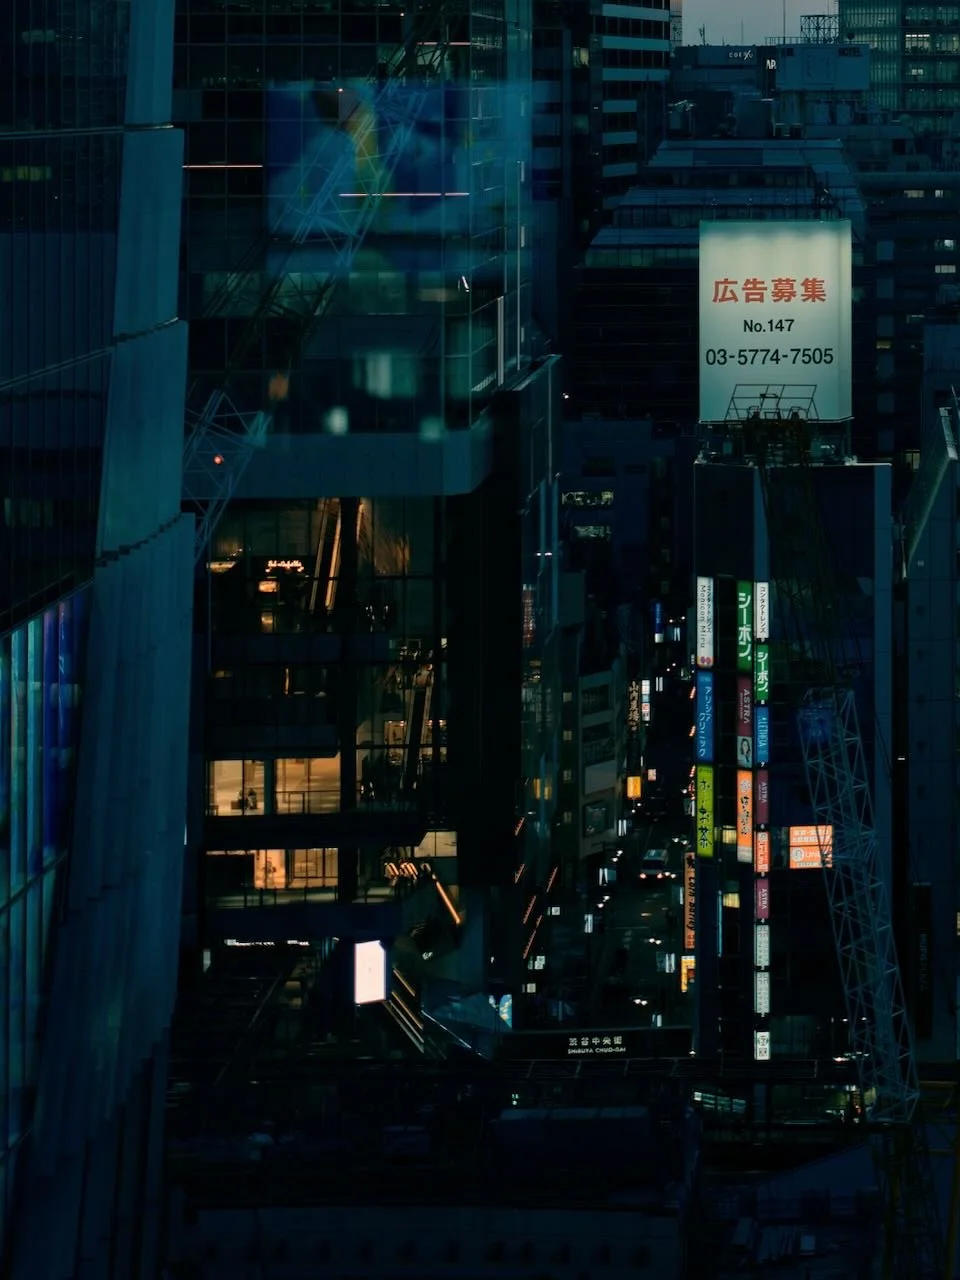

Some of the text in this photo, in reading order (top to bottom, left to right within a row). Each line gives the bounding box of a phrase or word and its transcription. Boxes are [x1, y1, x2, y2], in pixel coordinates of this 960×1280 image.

[712, 278, 827, 304] 広告募集
[743, 319, 795, 333] No.147
[705, 348, 834, 366] 03-5774-7505
[743, 688, 752, 724] ASTRA
